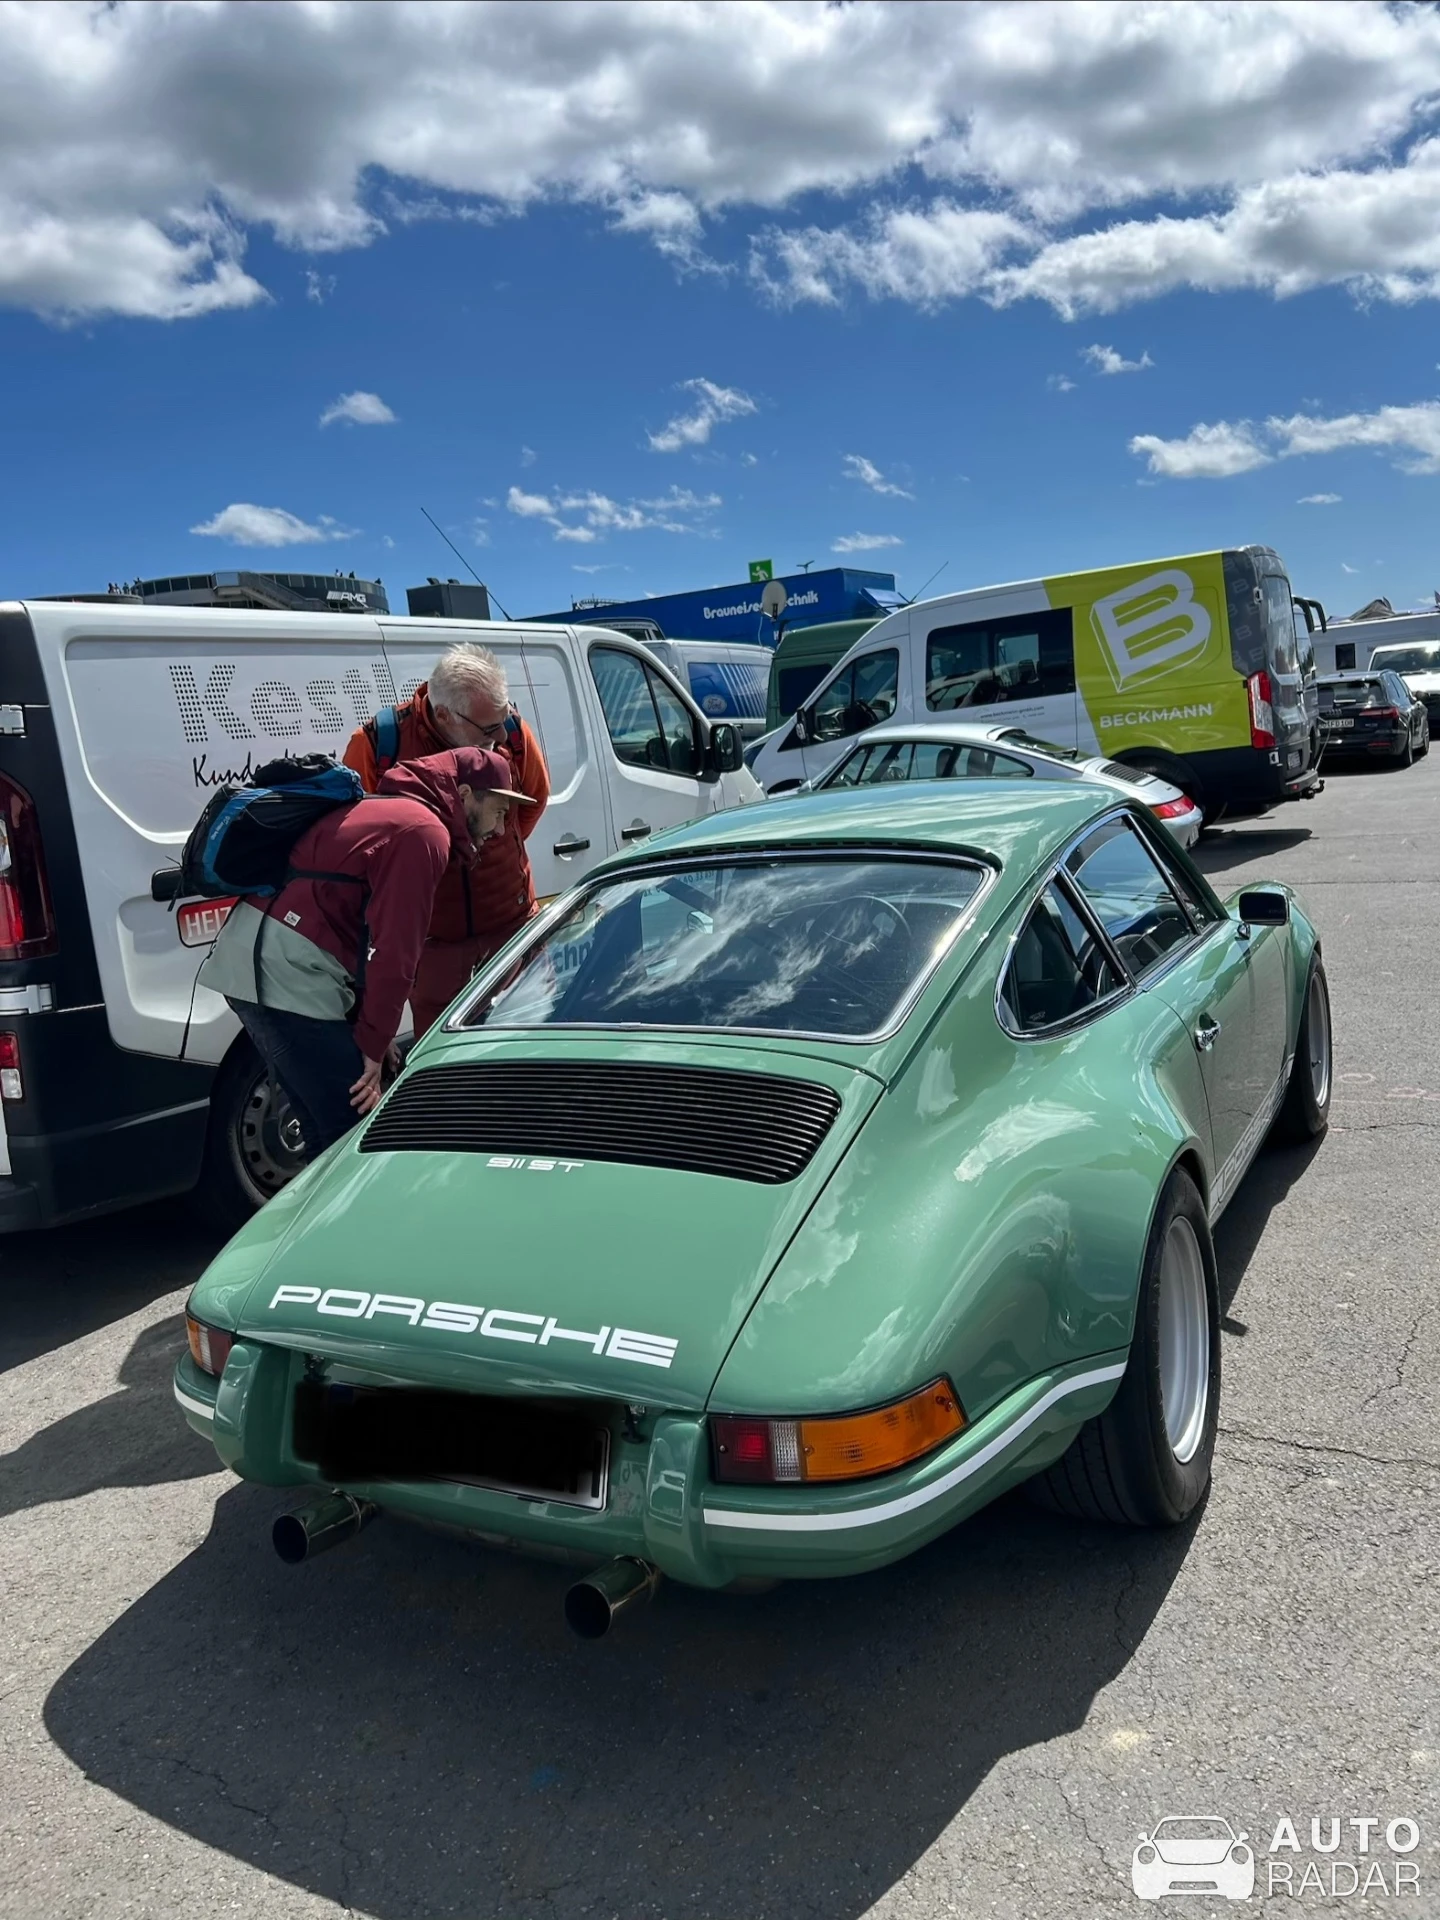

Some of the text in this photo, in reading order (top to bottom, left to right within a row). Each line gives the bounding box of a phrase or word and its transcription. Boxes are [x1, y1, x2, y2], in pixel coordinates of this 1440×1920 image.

[340, 591, 367, 604] AMG
[1090, 569, 1212, 693] B
[168, 663, 427, 744] Kestl
[1100, 702, 1214, 729] BECKMANN
[486, 1157, 585, 1173] 911 ST
[268, 1285, 680, 1369] PORSCHE
